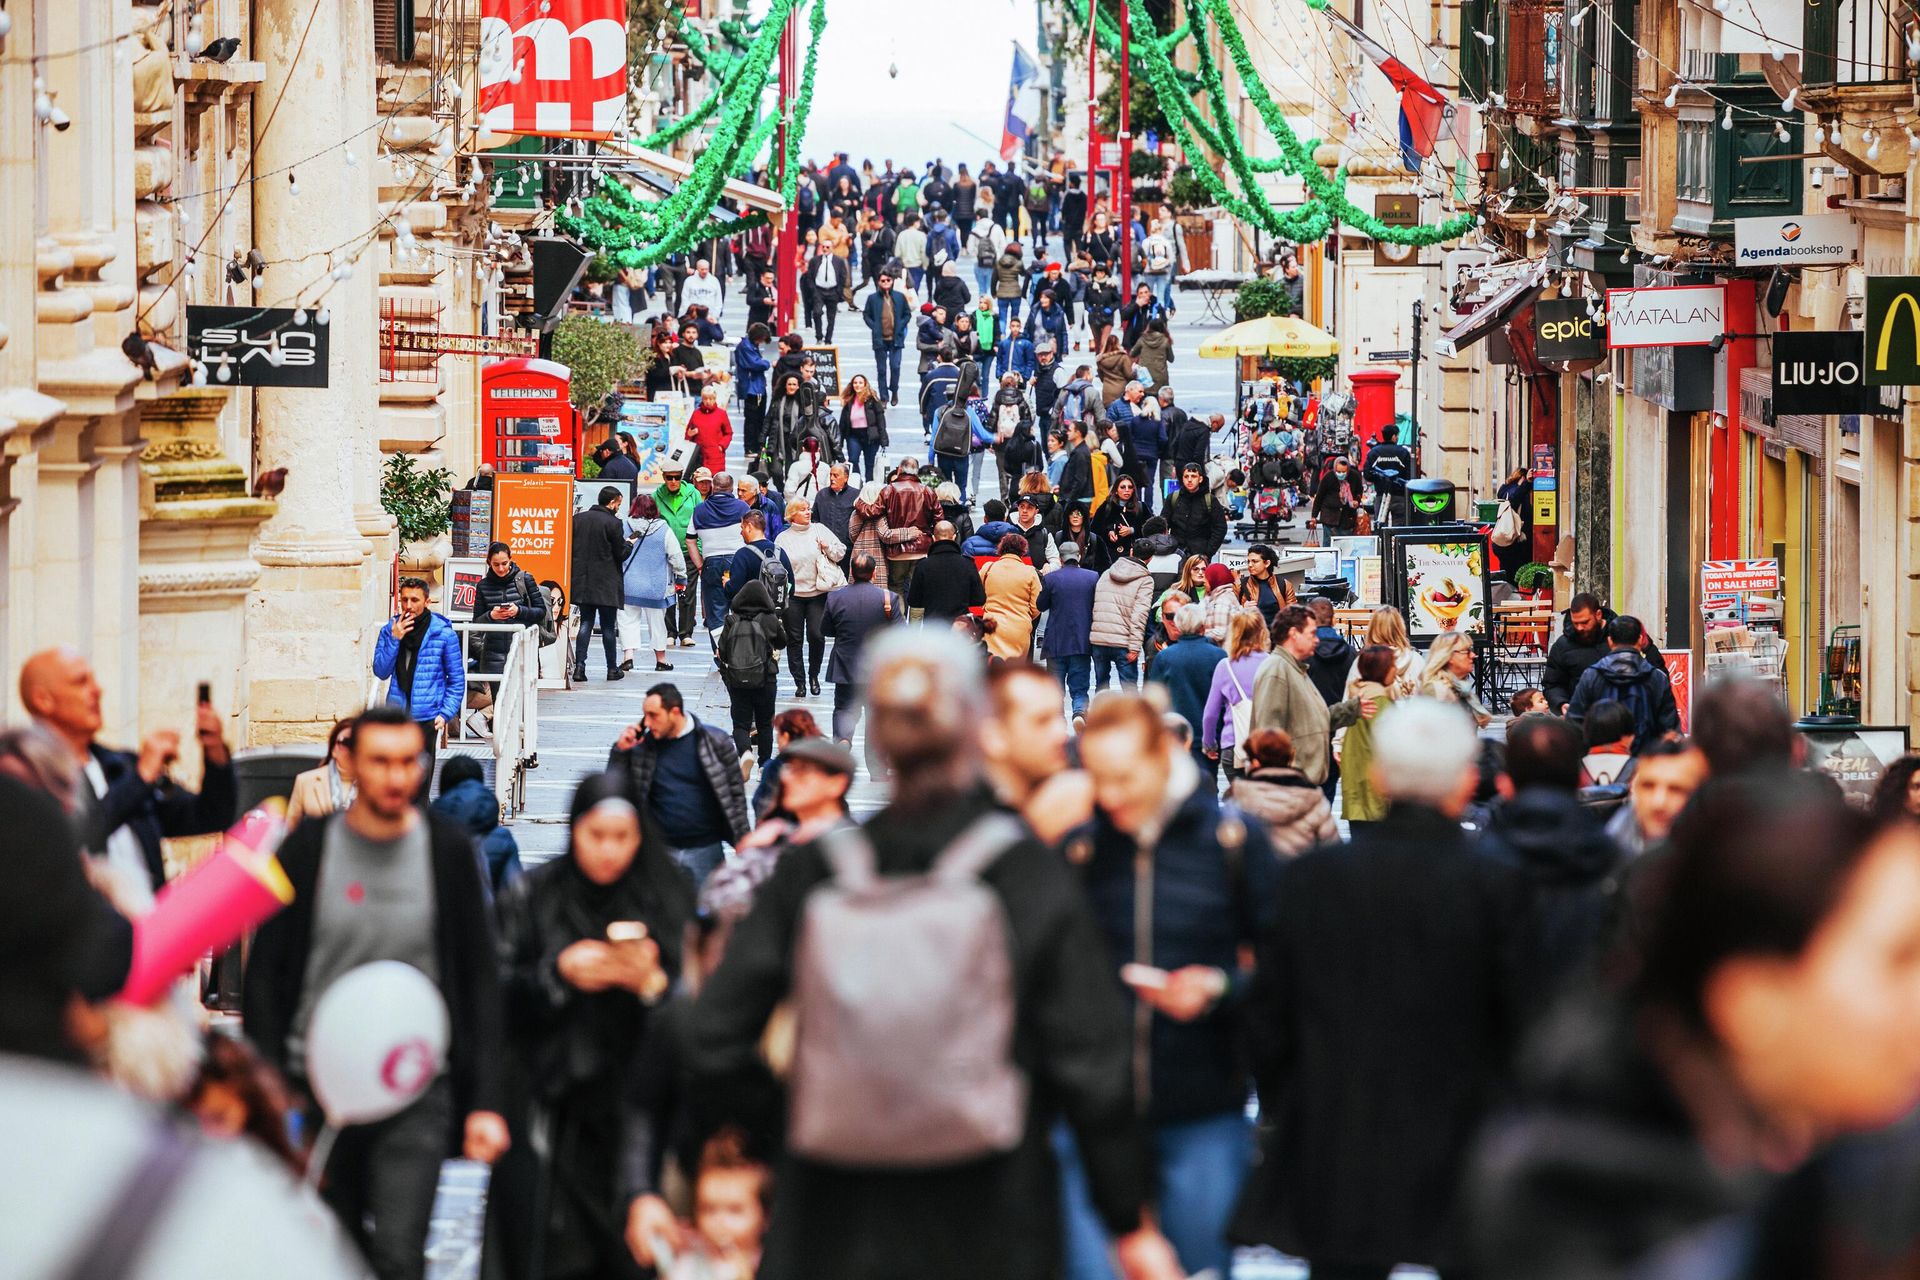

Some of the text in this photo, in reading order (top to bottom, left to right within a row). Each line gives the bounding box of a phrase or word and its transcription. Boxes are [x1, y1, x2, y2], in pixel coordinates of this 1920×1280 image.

[1614, 306, 1720, 326] MATALAN
[494, 388, 555, 398] TELEPHONE
[508, 507, 559, 518] JANUARY
[512, 520, 554, 534] SALE
[1708, 579, 1775, 590] ON SALE HERE
